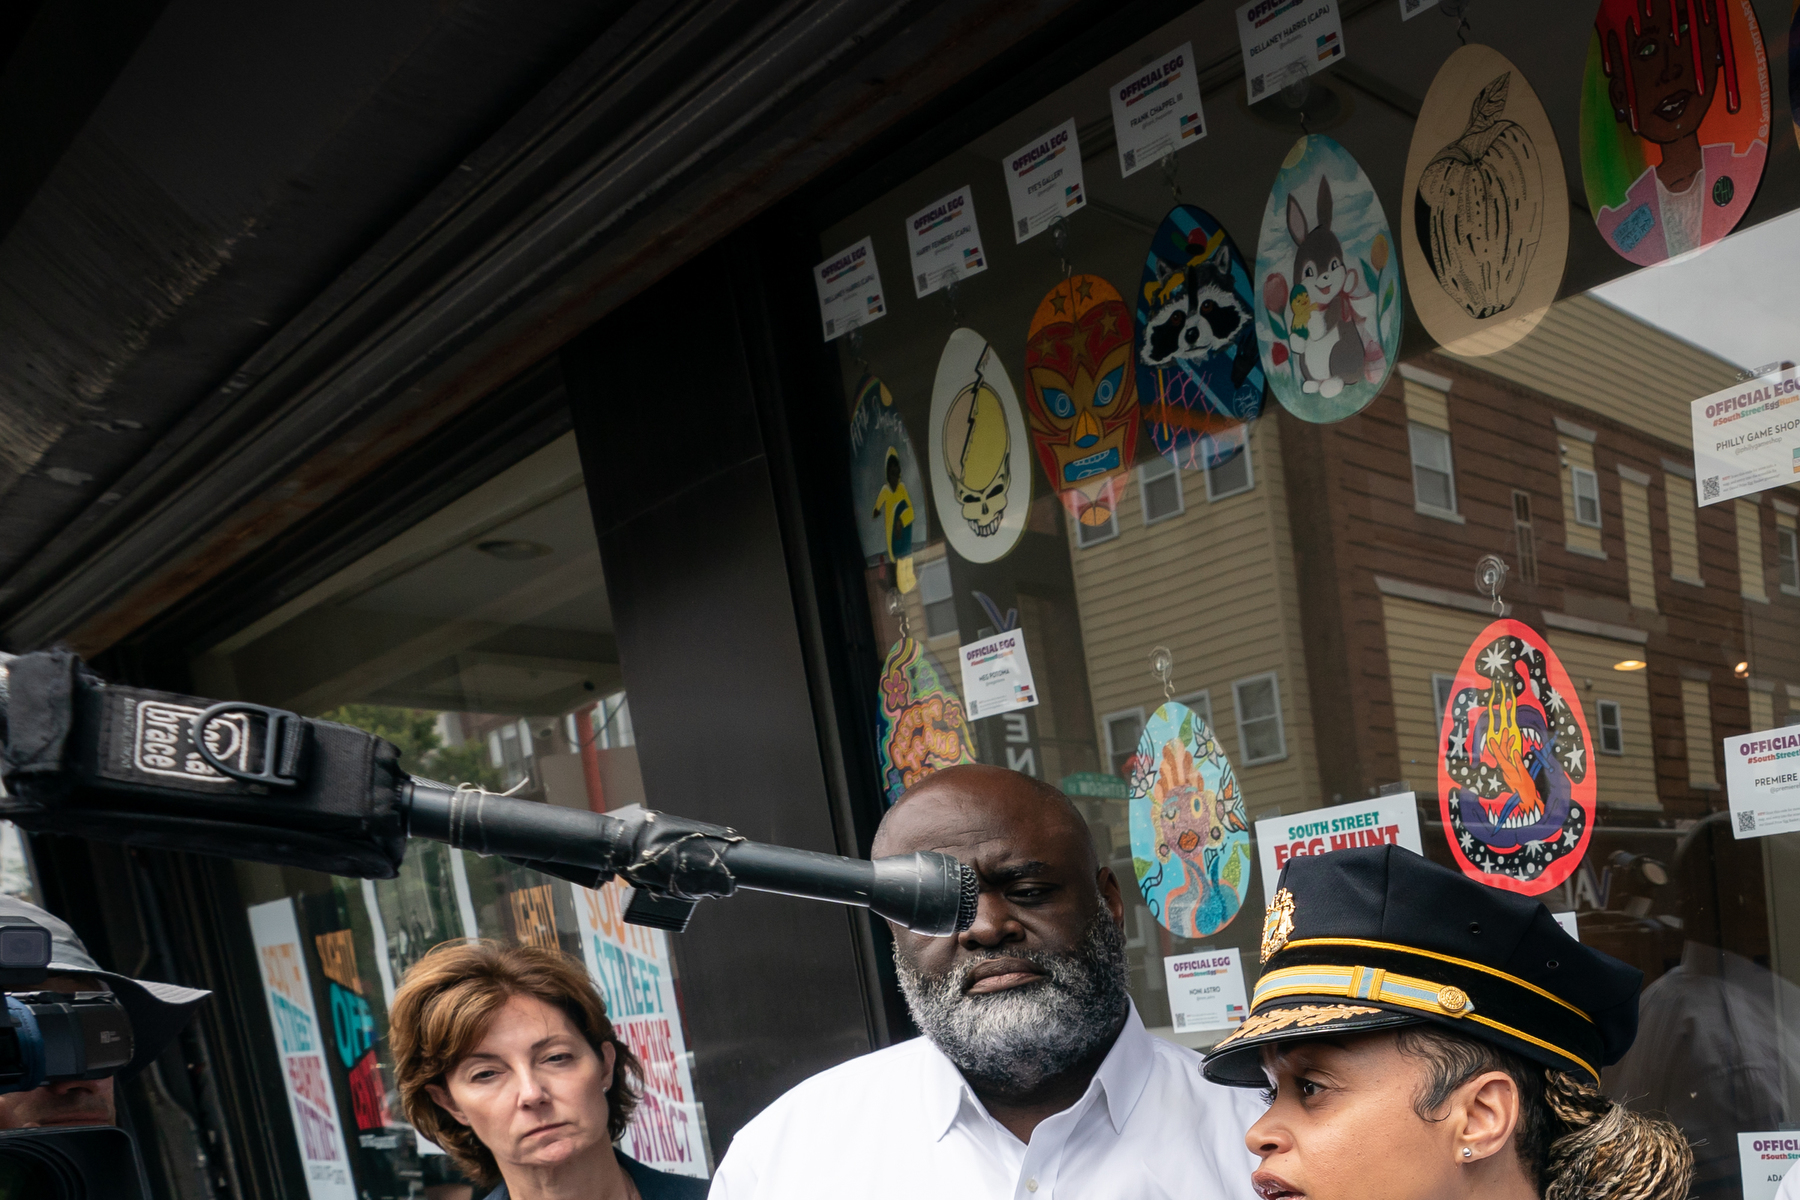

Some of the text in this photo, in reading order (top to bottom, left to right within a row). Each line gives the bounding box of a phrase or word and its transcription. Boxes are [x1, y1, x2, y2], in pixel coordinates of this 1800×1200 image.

[1250, 34, 1282, 57] DELLANEY
[1283, 18, 1308, 37] HARRIS
[1308, 4, 1330, 24] (CAPA)
[1120, 55, 1184, 101] OFFICIAL EGG
[1130, 111, 1148, 128] FRANK
[1012, 130, 1068, 171] OFFICIAL EGG
[914, 195, 964, 230] OFFICIAL EGG
[821, 246, 866, 278] OFFICIAL EGG
[1705, 387, 1771, 419] OFFICIAL
[1713, 395, 1799, 427] #SouthStreetEggHunt
[1716, 419, 1800, 451] PHILLY GAME SHOP
[967, 638, 1015, 660] OFFICIAL EGG
[143, 706, 190, 769] brace
[1755, 772, 1797, 787] PREMIERE
[1288, 811, 1379, 840] SOUTH STREET
[1274, 838, 1325, 870] EGG
[593, 934, 664, 1019] STREET
[1174, 956, 1230, 972] OFFICIAL EGG
[1204, 986, 1221, 994] ASTRO
[1767, 1174, 1785, 1182] ADA
